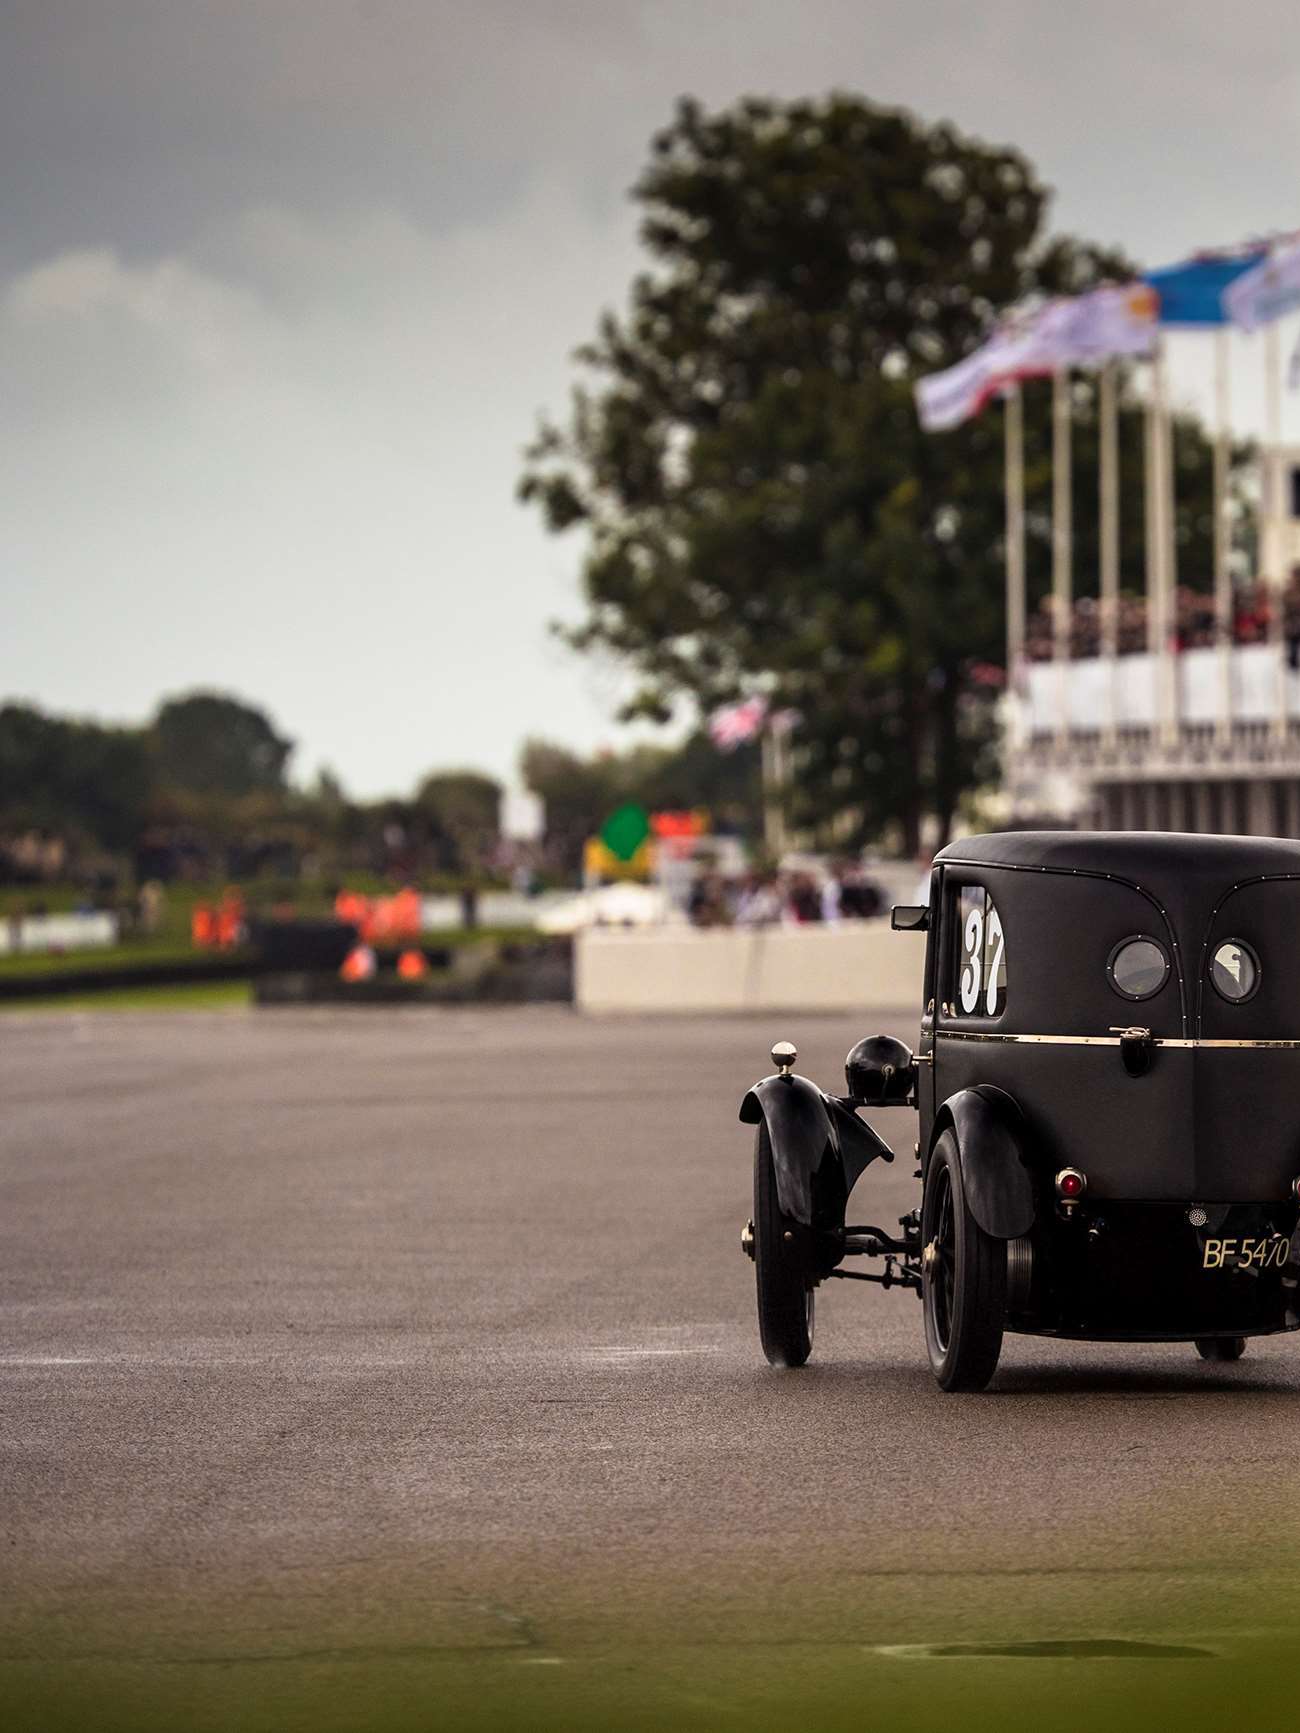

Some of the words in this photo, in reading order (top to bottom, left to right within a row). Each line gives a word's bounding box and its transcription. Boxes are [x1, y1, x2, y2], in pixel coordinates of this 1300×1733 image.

[961, 908, 1004, 1016] 37
[1203, 1239, 1237, 1268] BF
[1238, 1238, 1289, 1268] 5470
